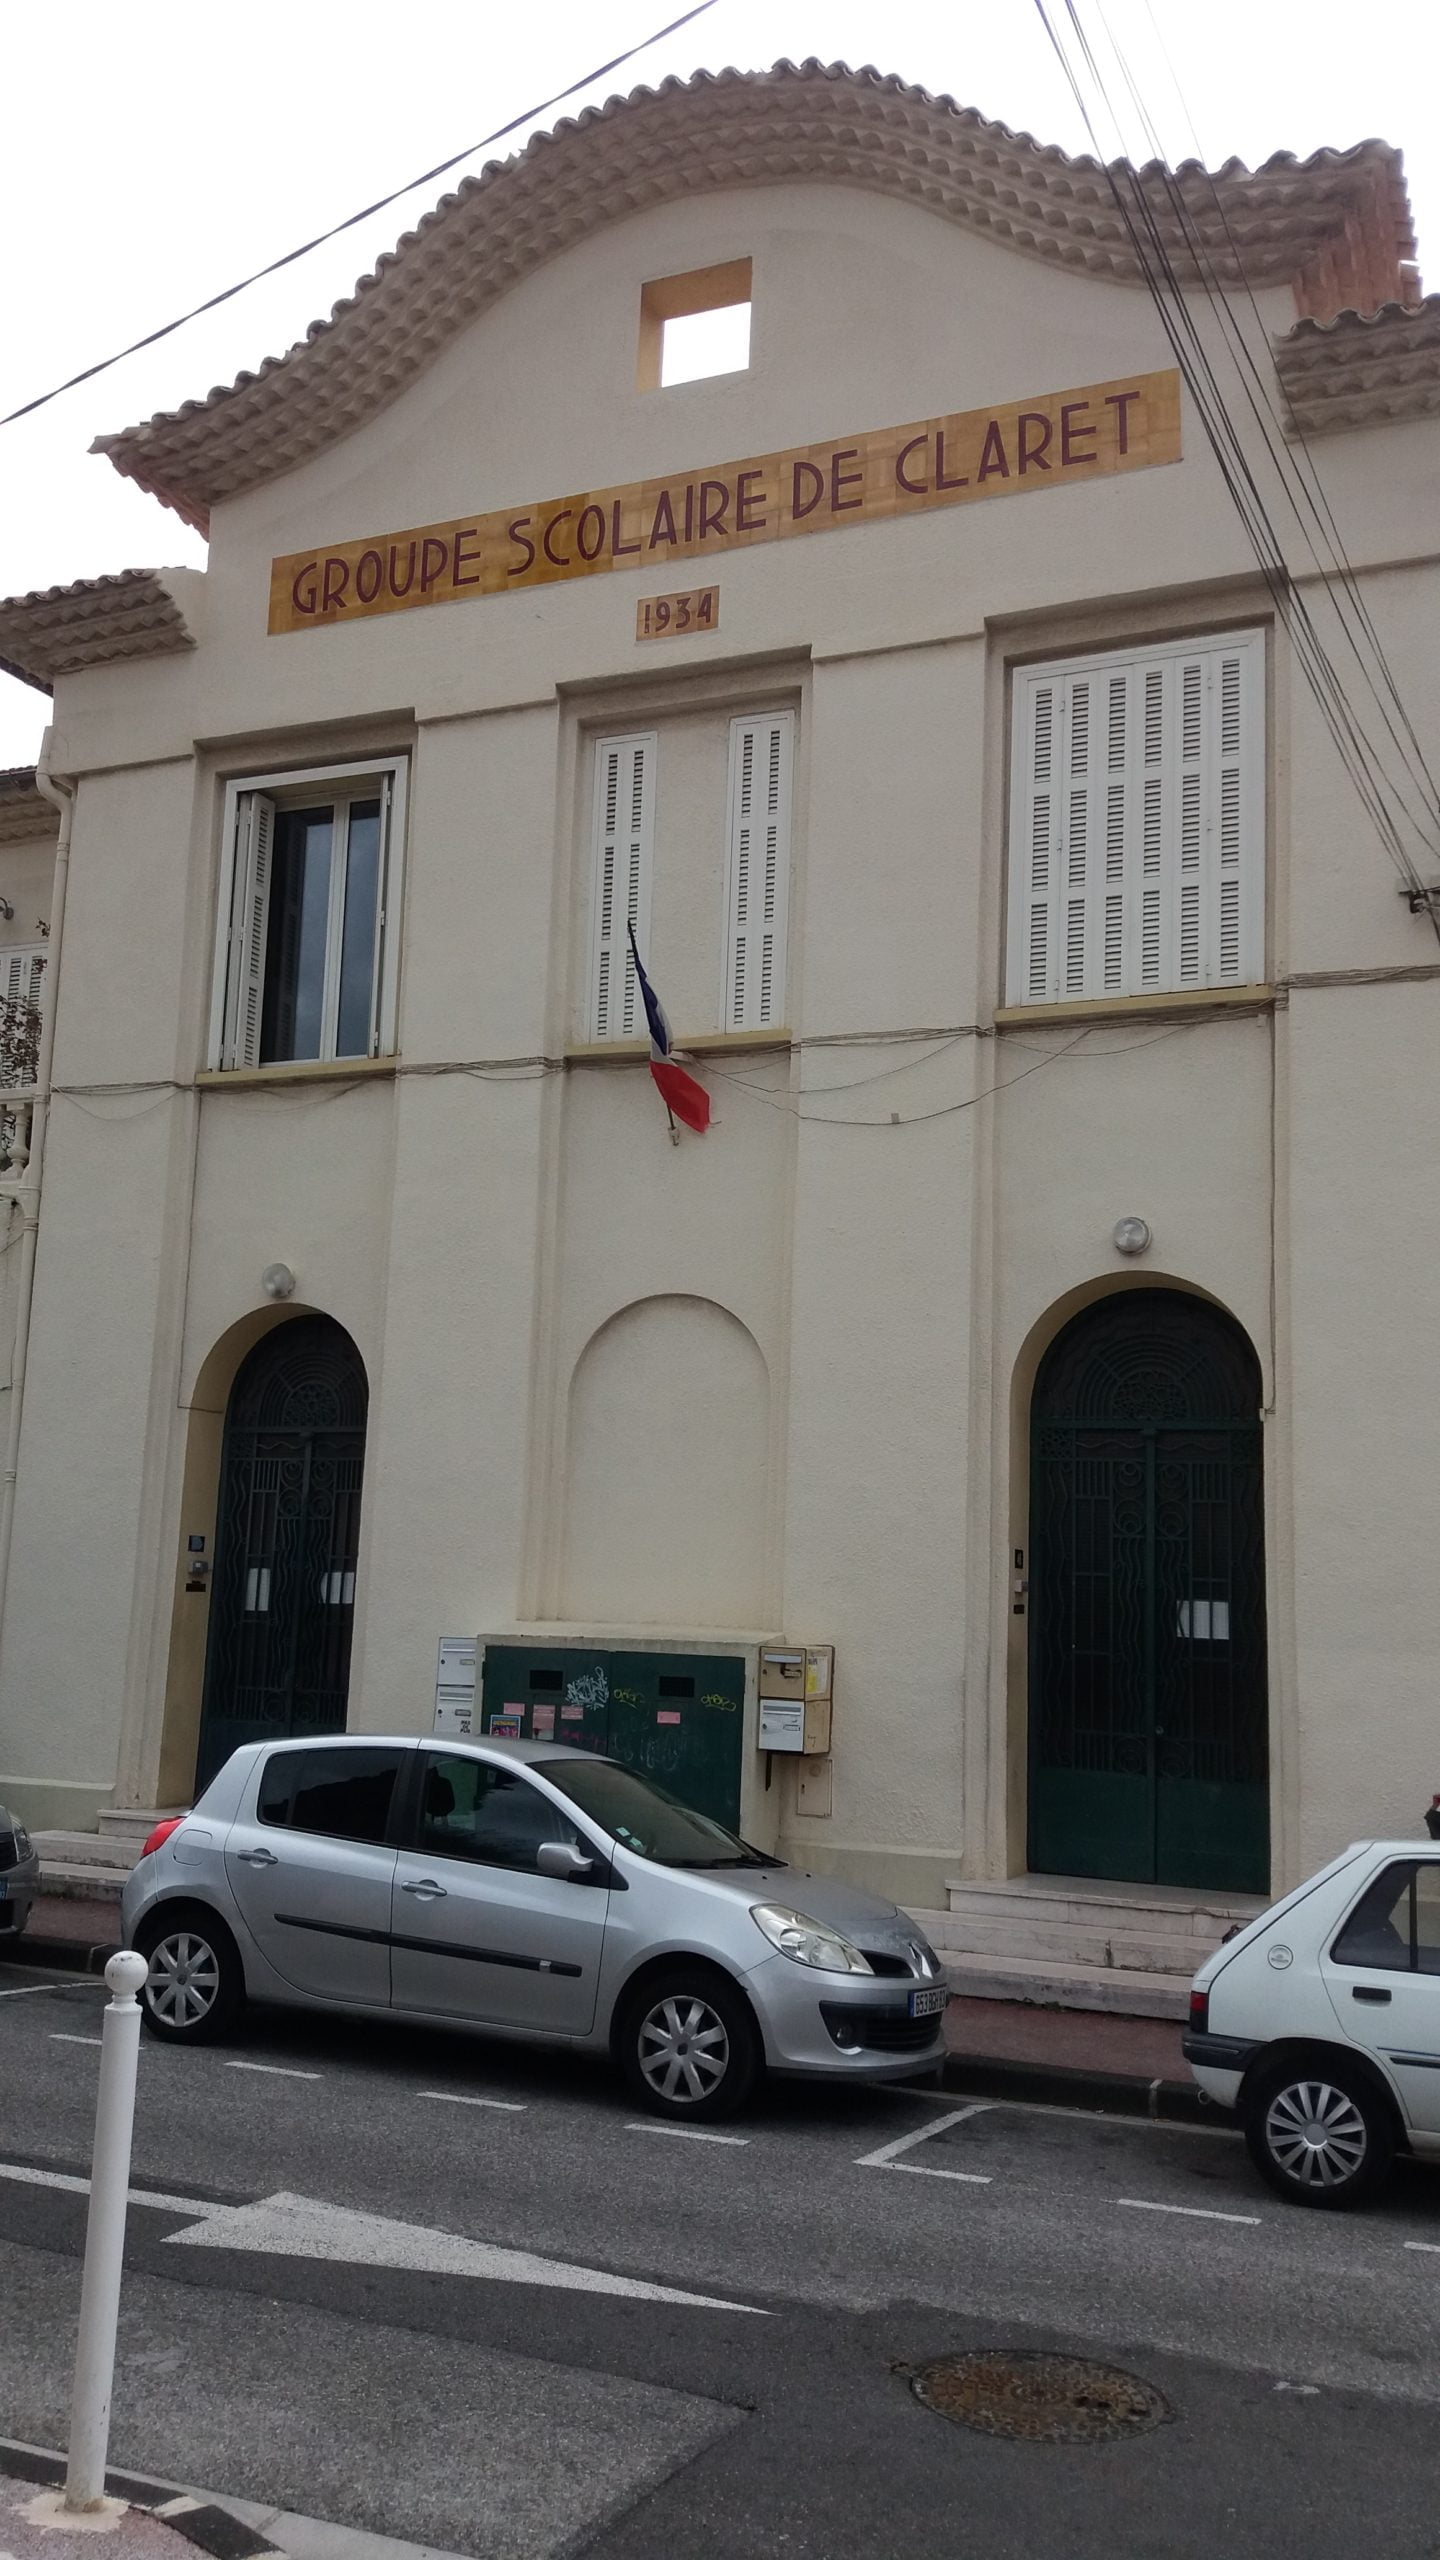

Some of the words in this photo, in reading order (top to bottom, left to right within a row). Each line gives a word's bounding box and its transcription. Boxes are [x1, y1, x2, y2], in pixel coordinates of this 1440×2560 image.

[292, 529, 482, 615] GROUPE
[507, 470, 767, 577] SCOLAIRE
[792, 449, 863, 521] DE
[895, 390, 1140, 494] CLARET
[644, 592, 712, 634] 1934
